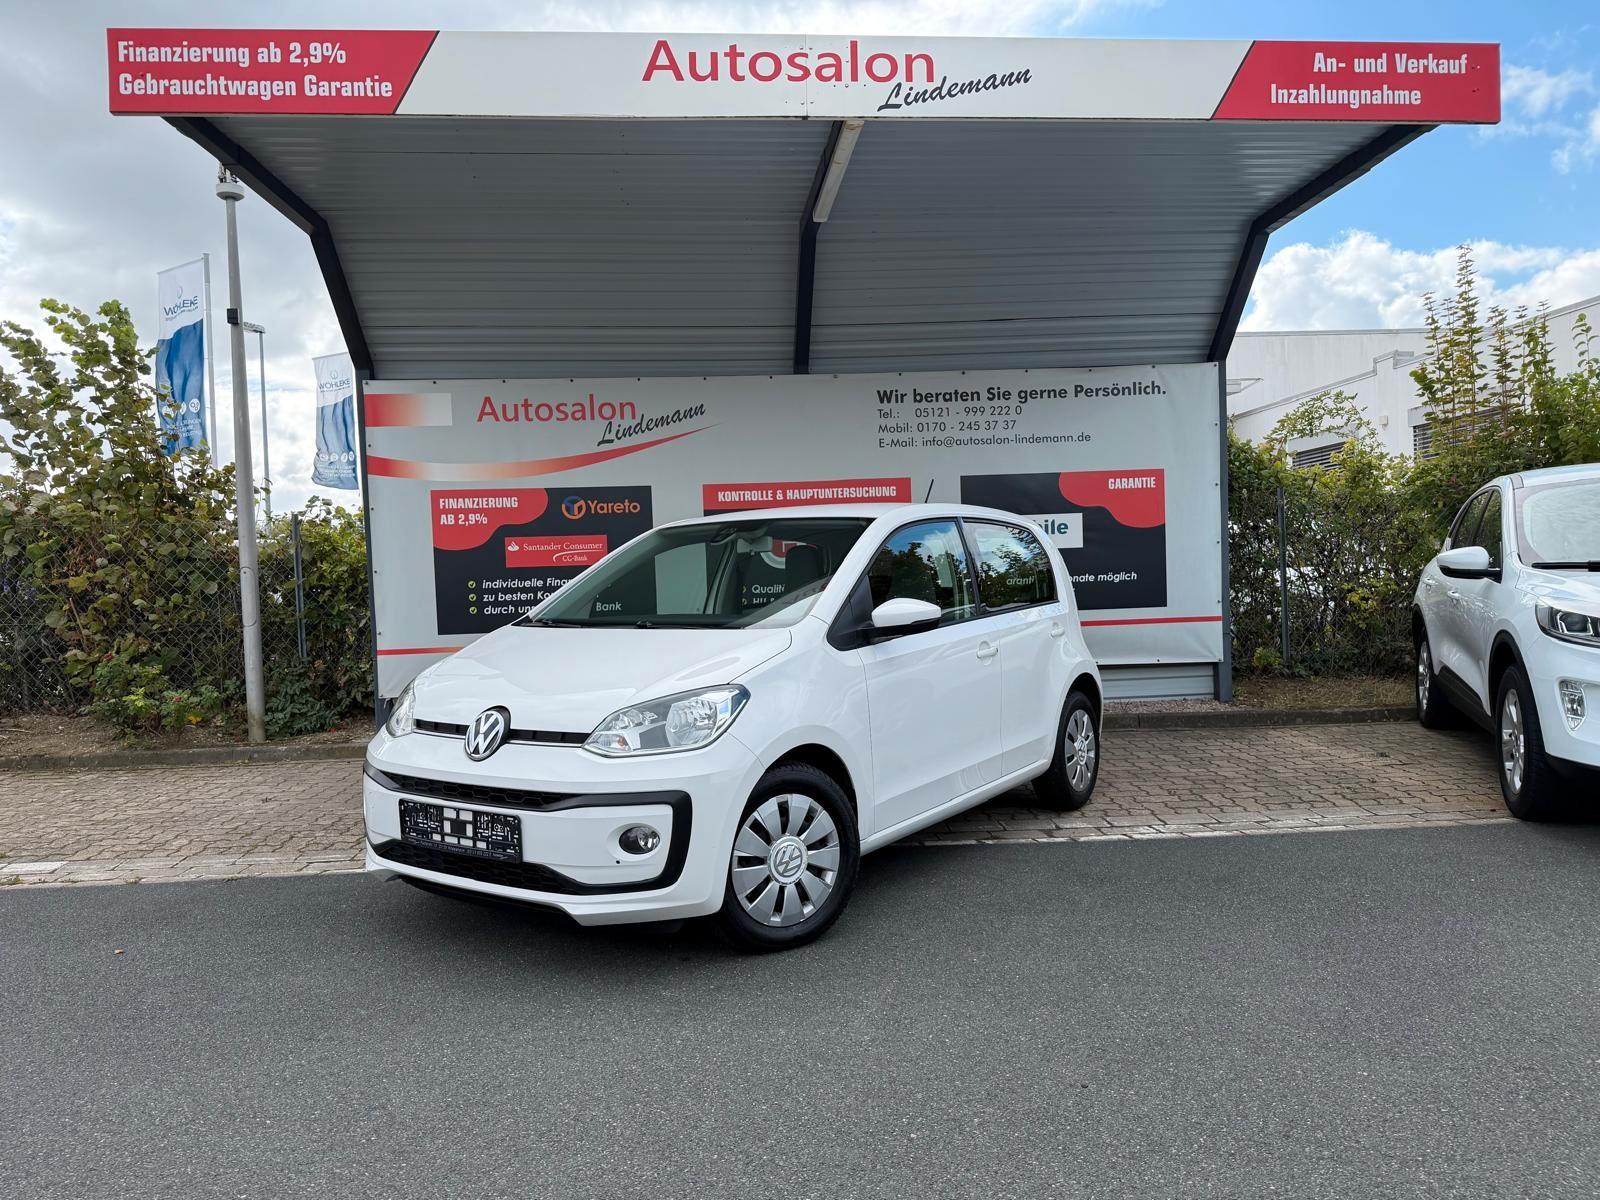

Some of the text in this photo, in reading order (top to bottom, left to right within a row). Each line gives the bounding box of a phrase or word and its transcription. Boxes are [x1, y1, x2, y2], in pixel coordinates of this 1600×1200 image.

[118, 41, 347, 68] Finanzierung ab 2,9%
[641, 39, 935, 83] Autosalon
[1313, 52, 1468, 74] An- und Verkauf
[118, 73, 393, 101] Gebrauchtwagen Garantie
[876, 67, 1032, 112] Lindemann
[1270, 84, 1422, 109] Inzahlungnahme
[876, 380, 1167, 405] Wir beraten Sie gerne Persönlich.
[477, 393, 637, 423] Autosalon
[877, 407, 901, 419] Tel.:
[914, 406, 951, 418] 05121
[963, 405, 986, 417] 999
[989, 405, 1012, 416] 222
[1015, 405, 1023, 416] 0
[597, 403, 706, 446] Lindemann
[878, 422, 913, 434] Mobil:
[916, 421, 947, 433] 0170
[958, 420, 981, 432] 245
[984, 420, 999, 431] 37
[1001, 419, 1017, 430] 37
[879, 431, 1092, 448] E-Mail: info@autosalon-lindemann.de
[1108, 476, 1157, 490] GARANTIE
[718, 486, 897, 503] KONTROLLE & HAUPTUNTERSUCHUNG
[439, 496, 519, 510] FINANZIERUNG
[587, 499, 641, 515] Yareto
[440, 514, 489, 527] AB 2,9%
[523, 541, 604, 552] Santander Consumer
[562, 554, 588, 563] CC-Bank
[482, 578, 544, 589] individuelle
[1097, 571, 1138, 583] möglich
[482, 590, 554, 602] zu besten Ko
[483, 604, 515, 615] durch
[595, 601, 622, 612] Bank
